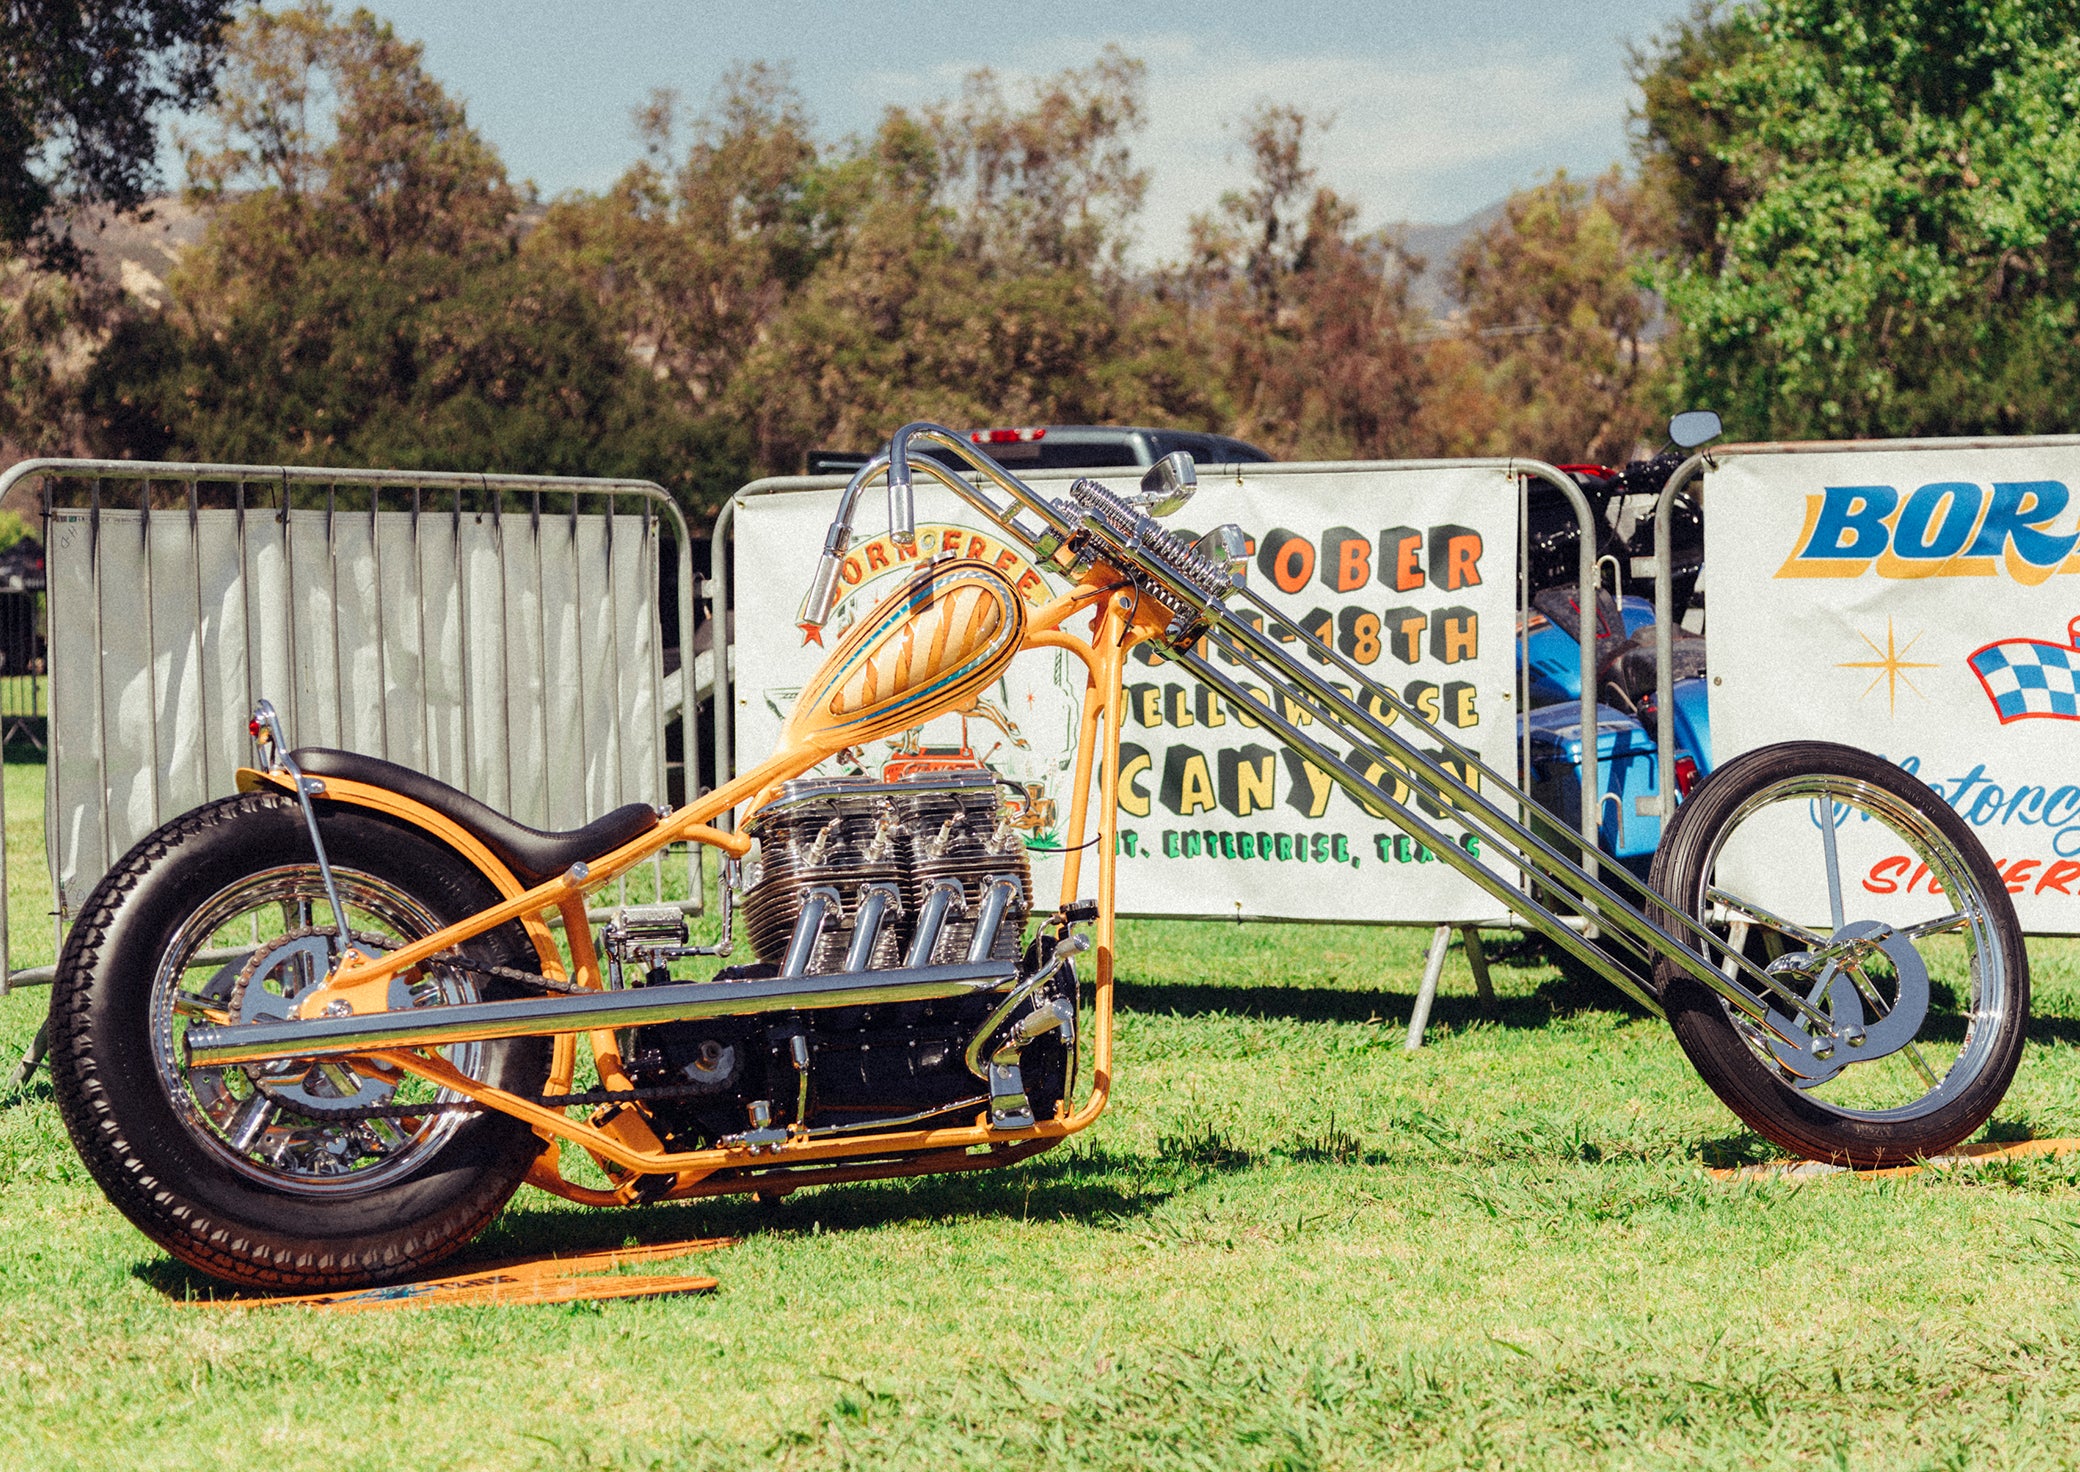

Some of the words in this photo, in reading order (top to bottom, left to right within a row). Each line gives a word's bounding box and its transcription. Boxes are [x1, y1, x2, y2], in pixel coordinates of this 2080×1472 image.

[832, 540, 918, 608] ORN
[939, 530, 1041, 600] FREE
[1167, 524, 1483, 594] OBER
[1772, 480, 2080, 586] BOR
[1098, 829, 1151, 859] T.
[1162, 829, 1361, 869] ENTERPRISE,
[1373, 832, 1480, 864] TEXS
